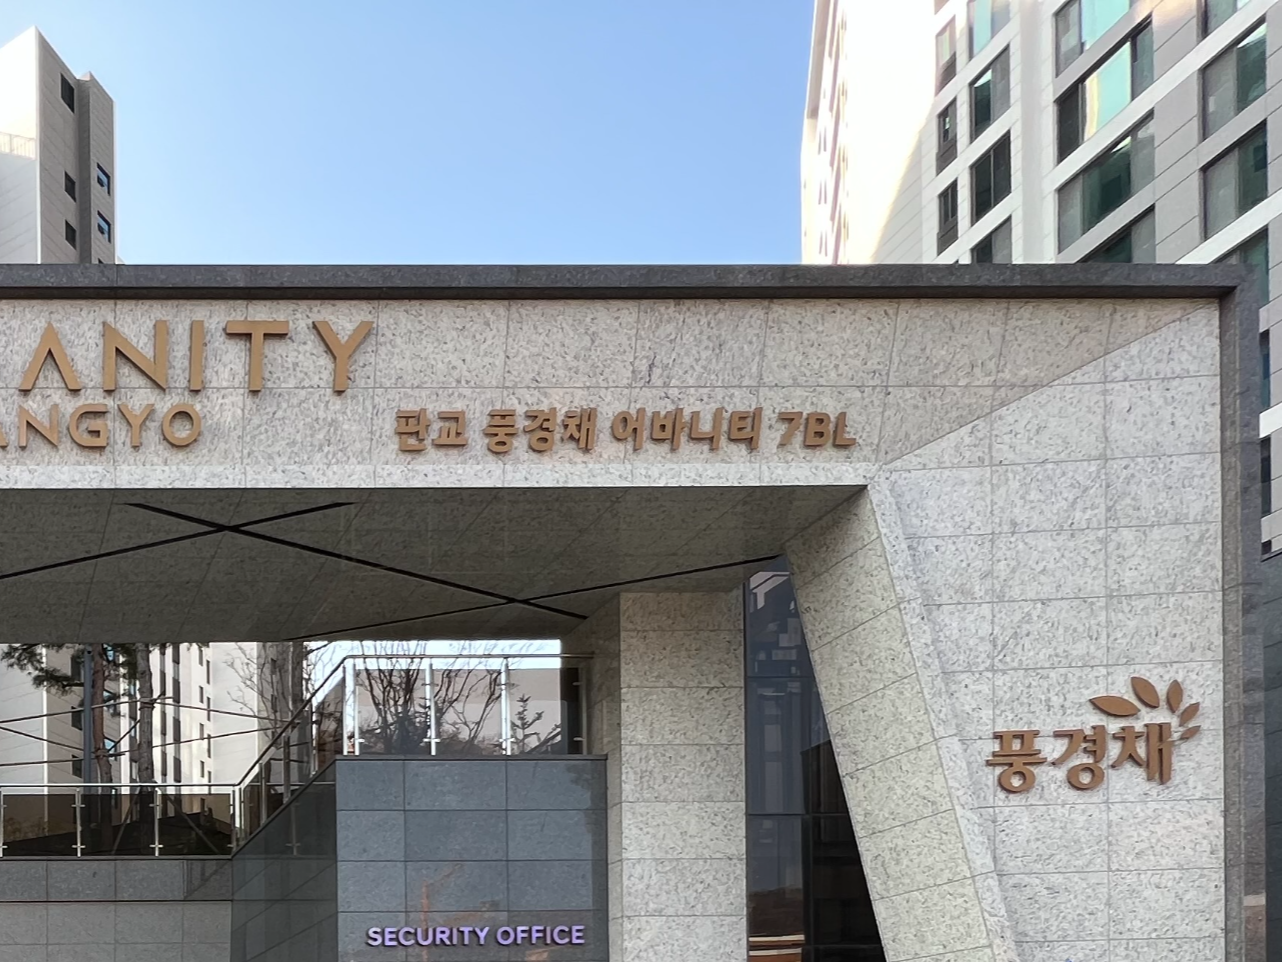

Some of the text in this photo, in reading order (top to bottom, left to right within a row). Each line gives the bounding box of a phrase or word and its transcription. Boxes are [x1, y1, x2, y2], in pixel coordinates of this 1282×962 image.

[394, 406, 858, 454] 판교 풍경채 어바니티 7BL
[985, 722, 1174, 793] 풍경채
[366, 925, 586, 947] SECURITY OFFICE
